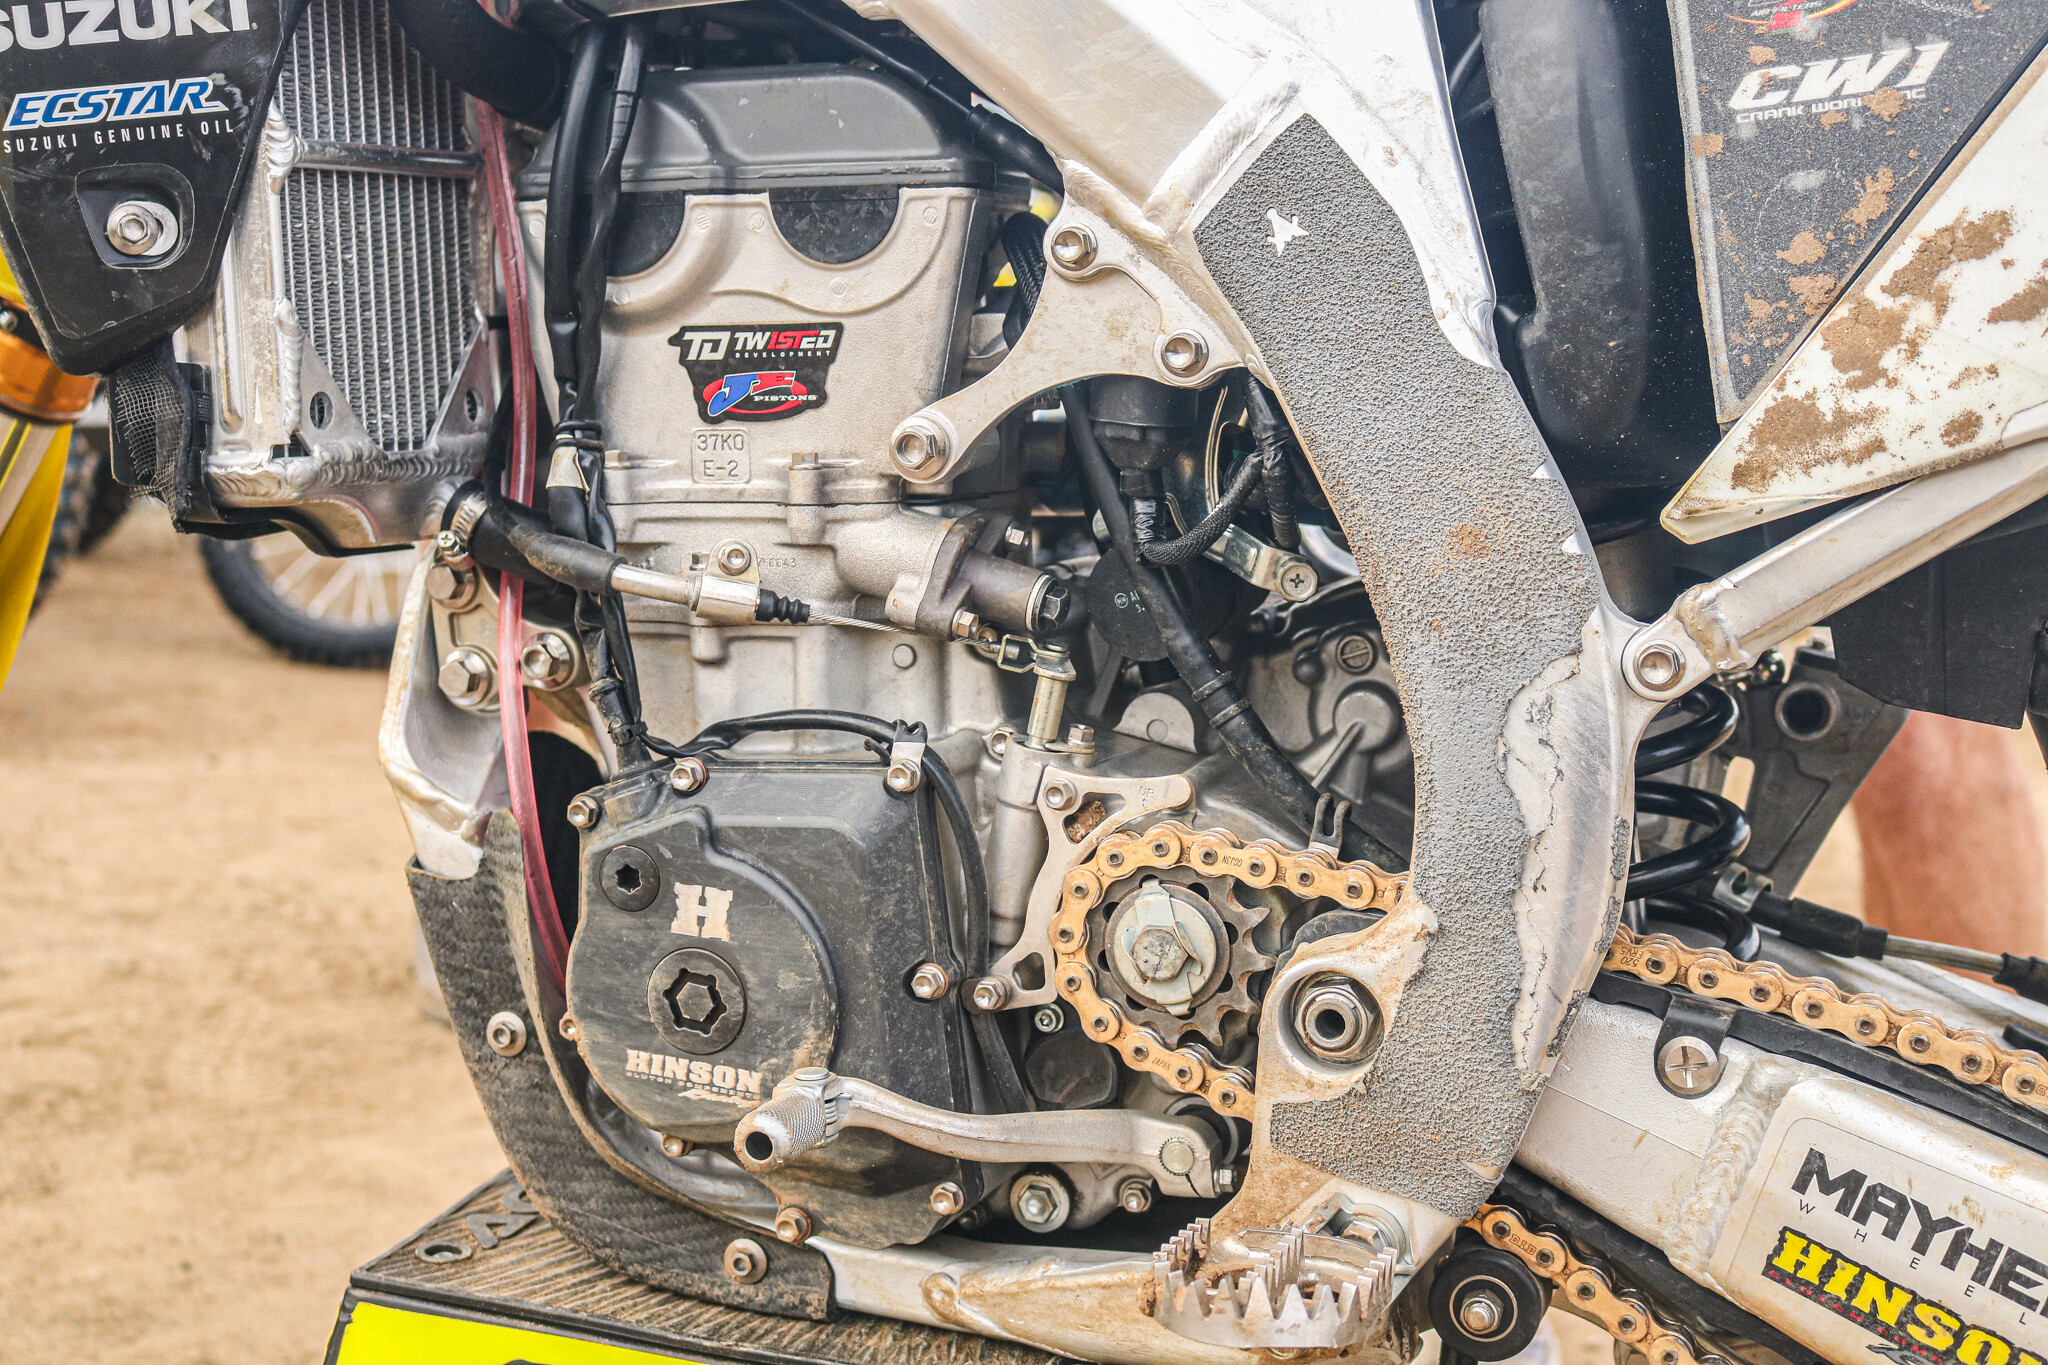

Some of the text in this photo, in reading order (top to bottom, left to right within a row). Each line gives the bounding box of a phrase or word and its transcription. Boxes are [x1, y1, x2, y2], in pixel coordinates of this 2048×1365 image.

[1728, 41, 1950, 110] CW1
[3, 77, 229, 131] ECSTAR
[1736, 104, 1803, 123] CRANK
[1811, 94, 1876, 114] WOR
[4, 119, 234, 153] SUZUKI GENUINE OIL
[682, 331, 731, 361] TD
[735, 350, 831, 359] DEVELOPMENT
[707, 371, 796, 417] JE
[753, 394, 817, 402] PISTONS
[703, 459, 739, 478] E-2
[670, 881, 734, 942] H
[625, 1048, 763, 1094] HINSON
[1151, 1056, 1172, 1071] JAPAN
[1790, 1147, 2048, 1318] MAYHE
[1771, 1229, 2046, 1365] HINSO
